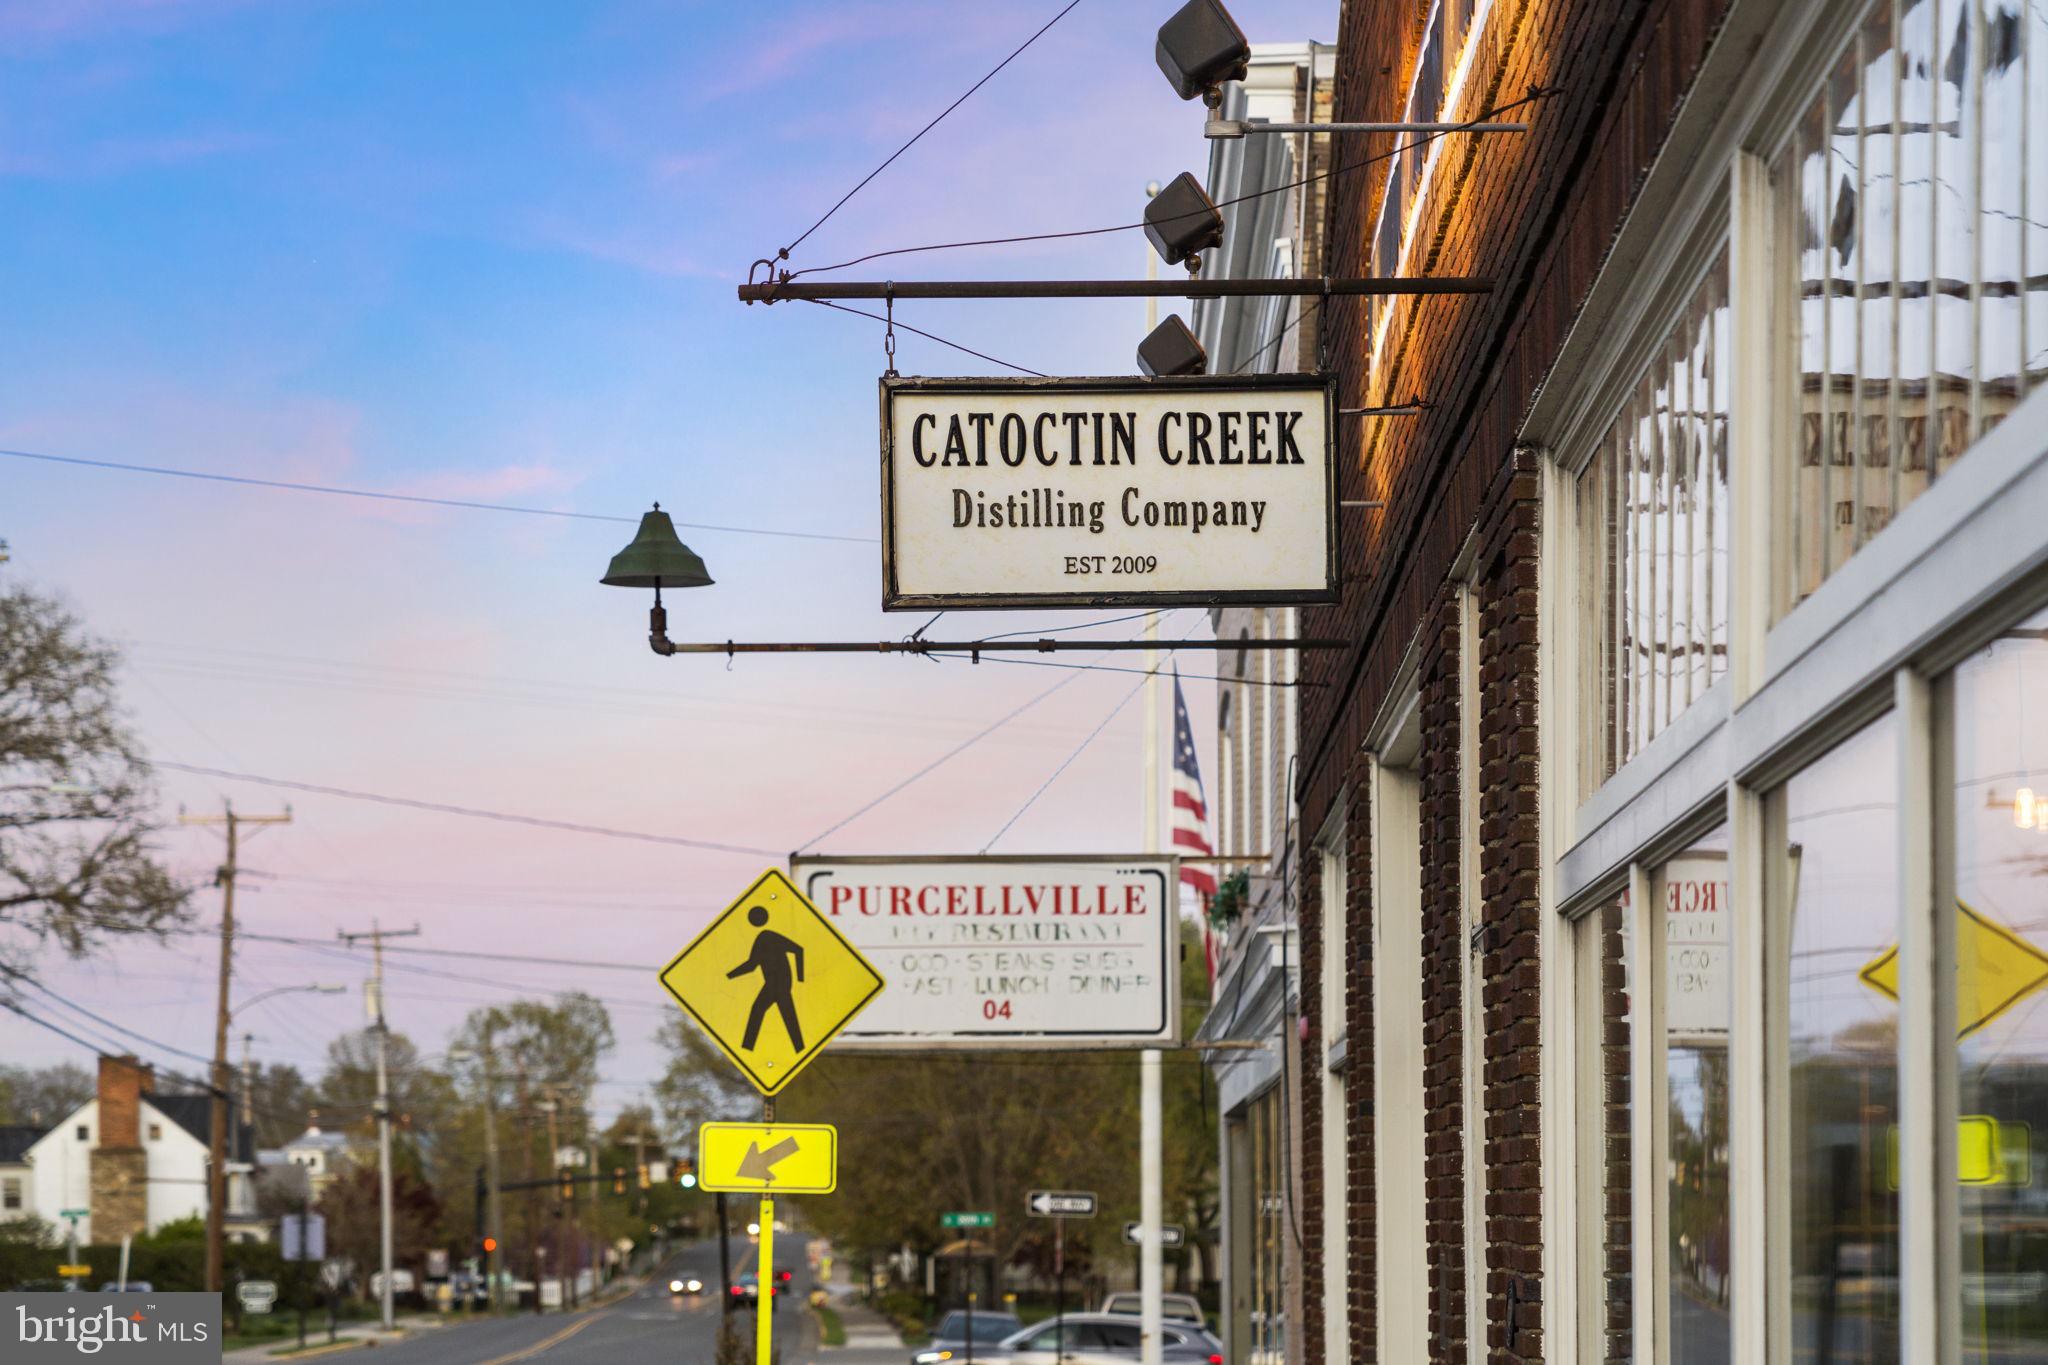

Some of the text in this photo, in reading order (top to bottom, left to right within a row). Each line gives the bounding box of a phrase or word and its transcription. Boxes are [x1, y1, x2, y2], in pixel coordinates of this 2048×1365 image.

[912, 411, 1305, 467] CATOCTIN CREEK
[952, 487, 1267, 533] Distilling Company
[1064, 556, 1158, 574] EST 2009
[830, 885, 1147, 916] PURCELLVILLE
[967, 952, 1054, 972] SEAKS
[975, 976, 1049, 995] LUNCH
[983, 999, 1013, 1020] 04
